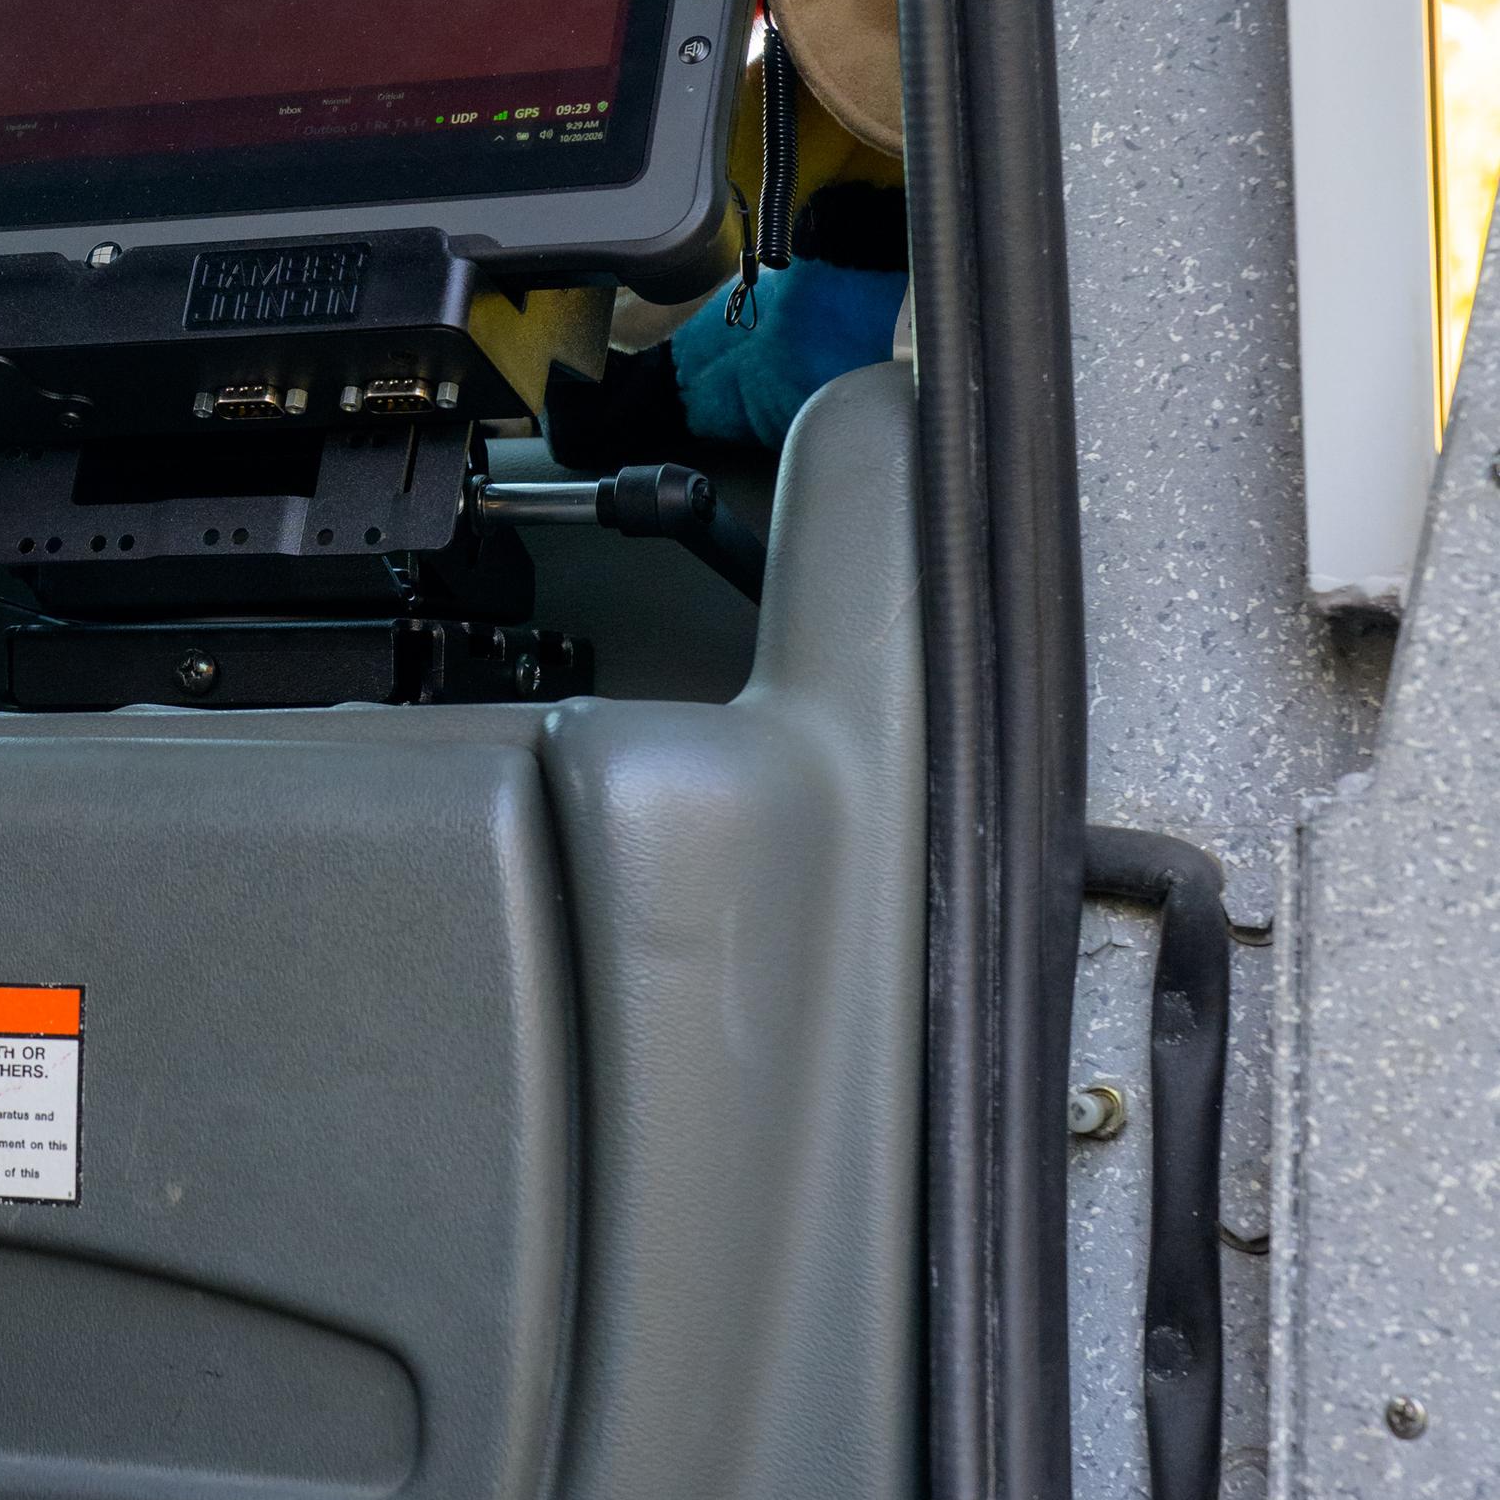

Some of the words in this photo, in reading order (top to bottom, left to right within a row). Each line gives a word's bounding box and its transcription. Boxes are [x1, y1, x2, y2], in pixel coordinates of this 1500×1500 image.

[278, 105, 303, 116] Inbox
[514, 106, 541, 120] GPS
[555, 102, 592, 116] 09:29
[451, 112, 479, 124] UDP
[565, 121, 584, 131] 9:29
[583, 120, 600, 130] AM
[22, 1046, 46, 1060] OR
[34, 1111, 55, 1122] and
[30, 1141, 44, 1151] on
[48, 1140, 68, 1152] this
[4, 1167, 16, 1178] of
[20, 1167, 40, 1179] this
